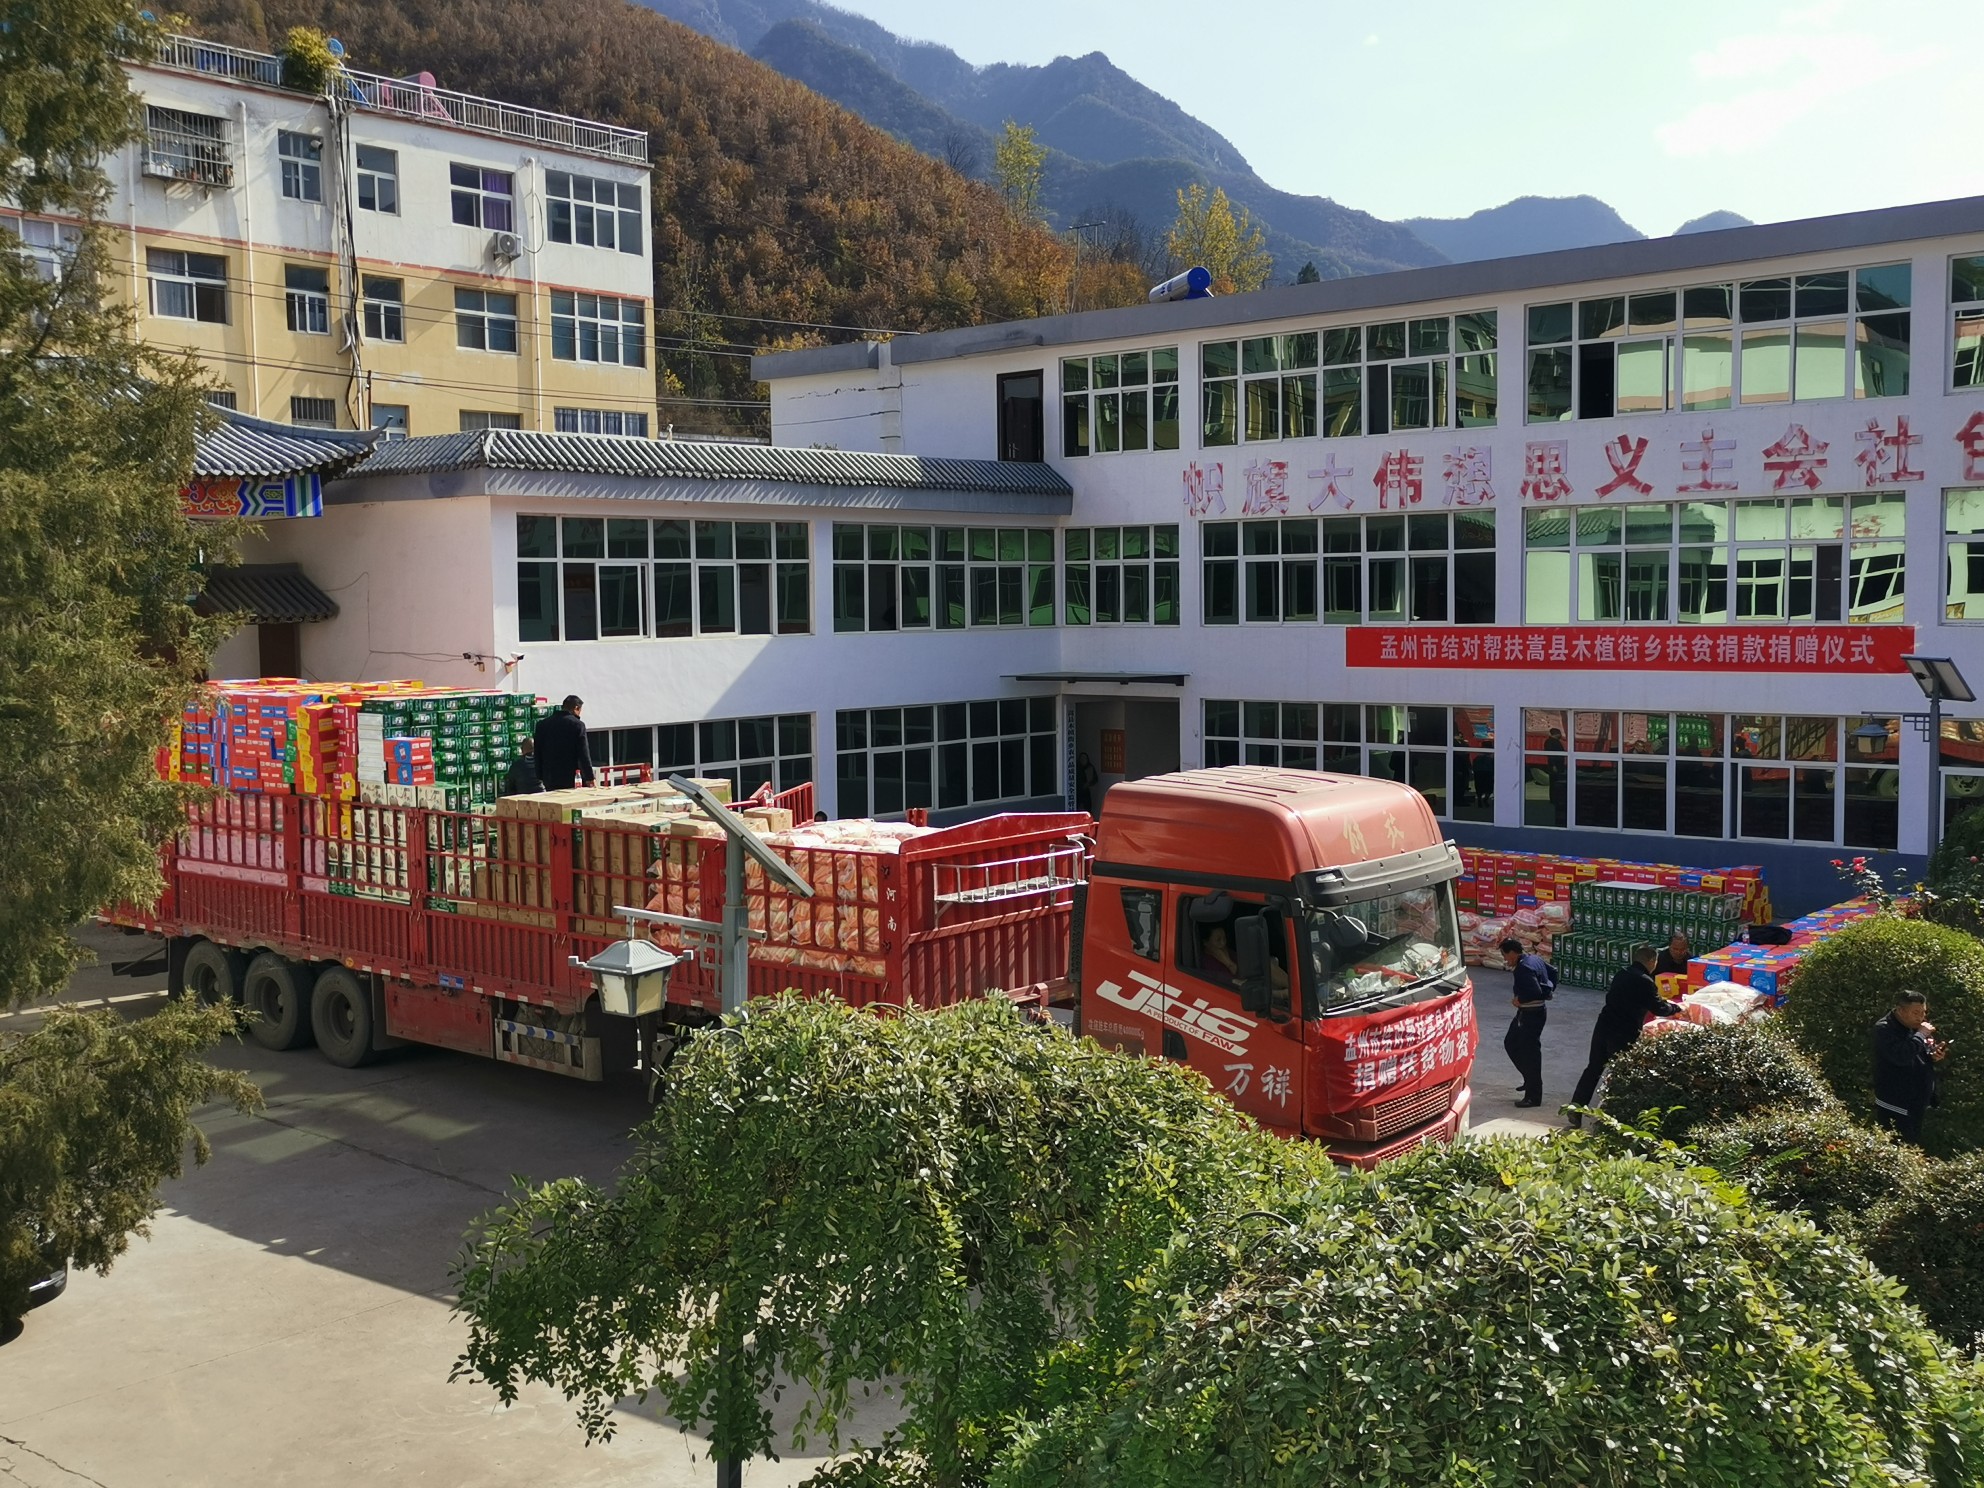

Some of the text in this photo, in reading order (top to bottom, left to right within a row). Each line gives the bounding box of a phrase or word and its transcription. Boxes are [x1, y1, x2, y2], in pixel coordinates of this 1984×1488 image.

[1380, 634, 1875, 665] 孟州市结对帮扶嵩县木植街乡扶贫捐款捐赠仪式
[1153, 1011, 1189, 1030] PRODUCT
[1188, 1026, 1200, 1035] OF
[1201, 1032, 1235, 1051] FAW
[1353, 1031, 1469, 1093] 捐赠扶贫物资
[1223, 1063, 1294, 1109] 万祥
